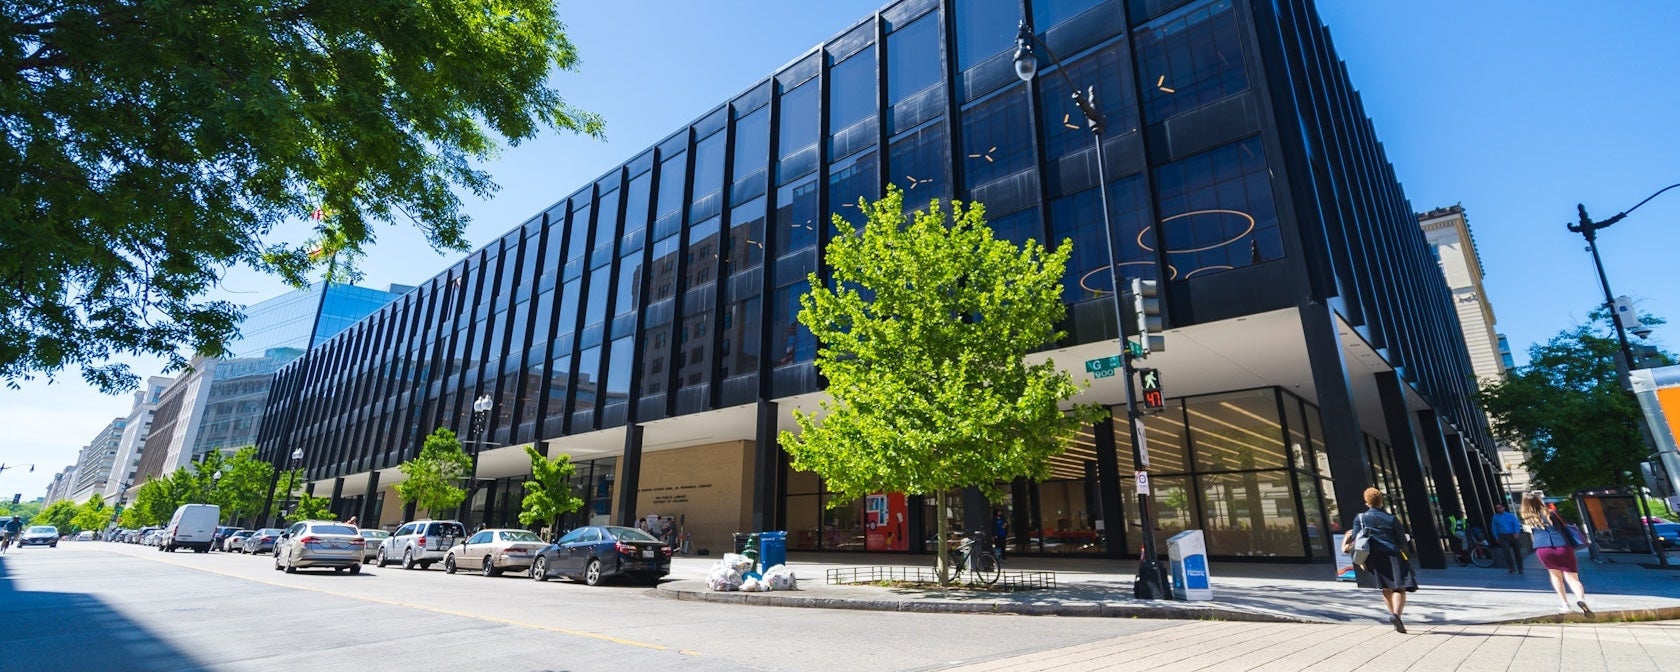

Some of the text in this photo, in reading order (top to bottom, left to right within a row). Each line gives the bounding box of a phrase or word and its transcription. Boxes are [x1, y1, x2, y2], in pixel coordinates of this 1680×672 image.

[1093, 360, 1101, 370] G
[1095, 368, 1114, 379] 900
[1146, 391, 1161, 407] 47
